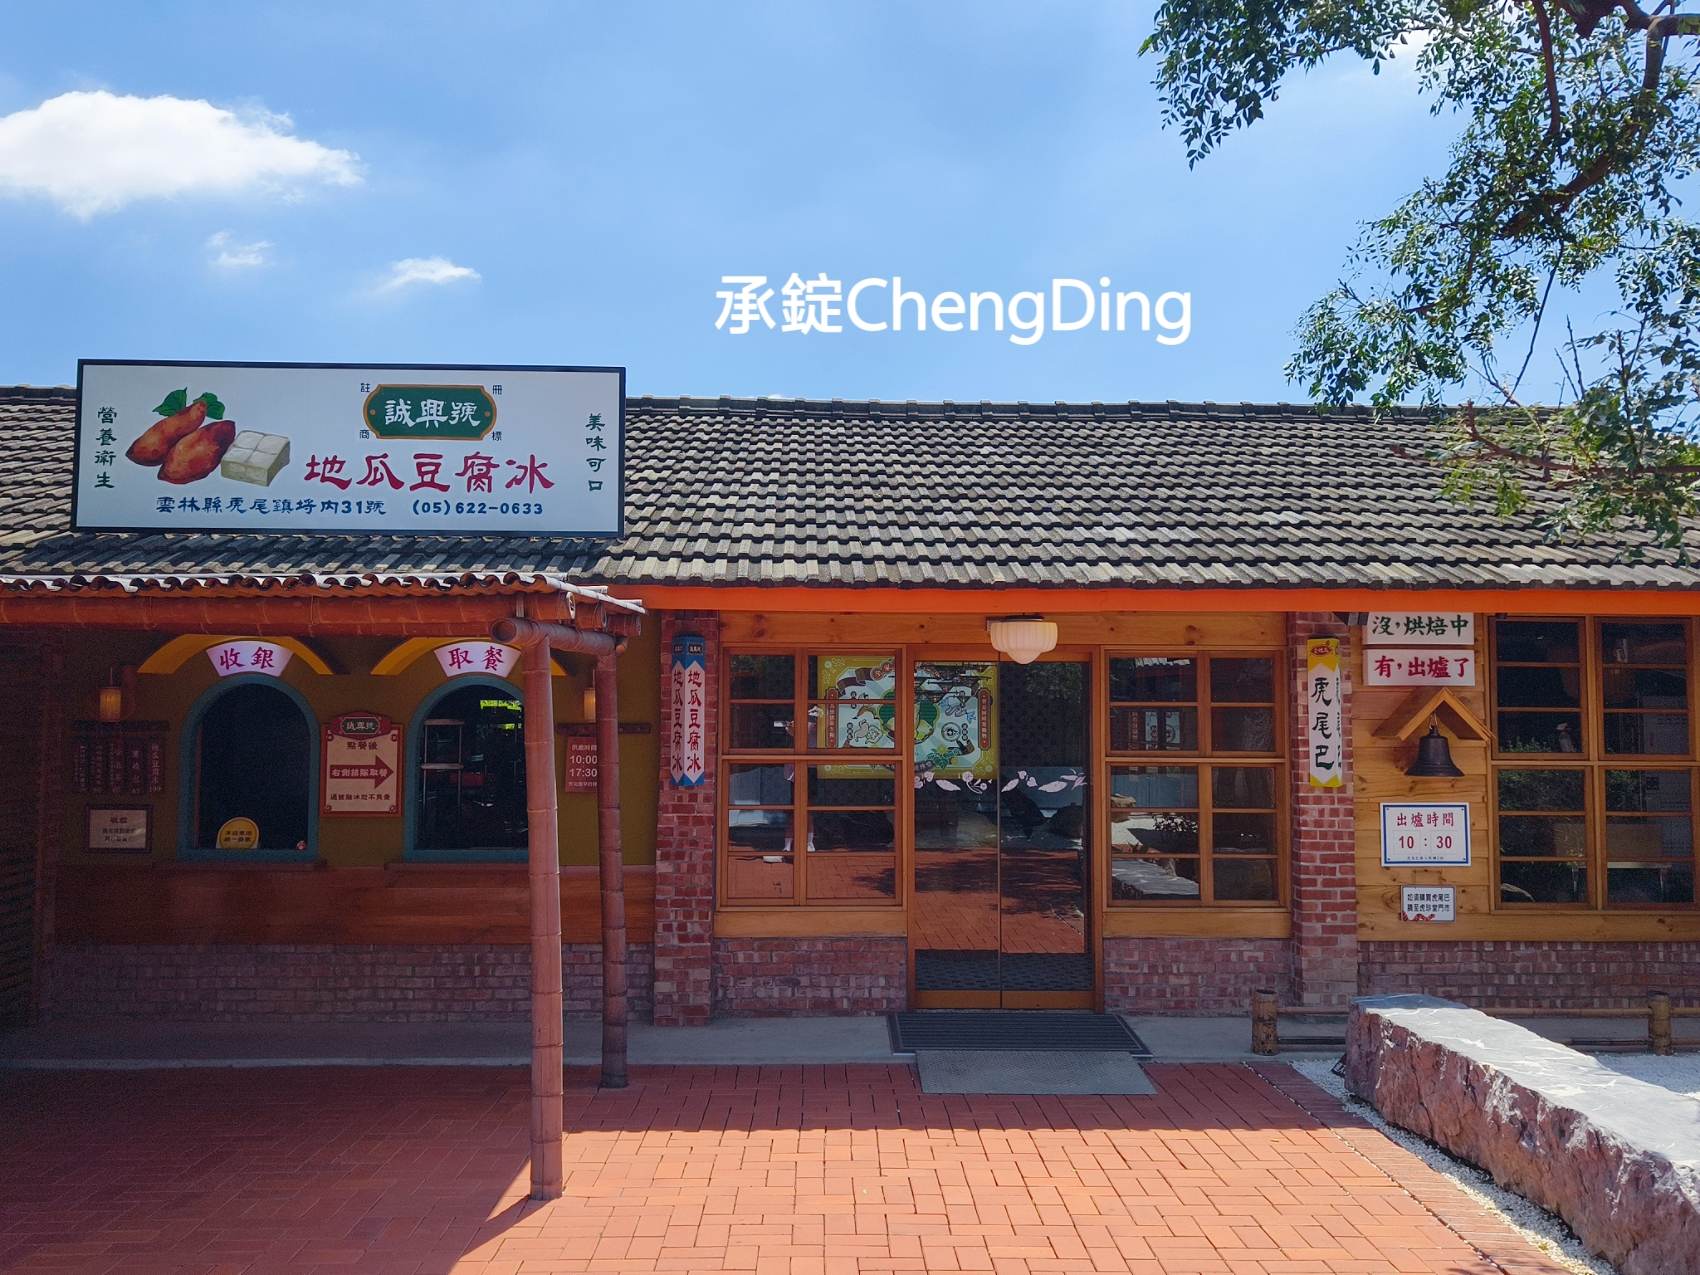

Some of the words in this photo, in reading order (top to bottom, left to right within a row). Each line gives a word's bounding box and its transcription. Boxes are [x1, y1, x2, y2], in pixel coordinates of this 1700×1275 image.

[384, 398, 481, 429] 誠興號
[584, 412, 608, 493] 美味可口
[303, 451, 555, 494] 地瓜豆腐冰
[411, 499, 545, 516] (05)622-0633
[218, 646, 276, 670] 收銀
[448, 645, 505, 672] 取餐
[672, 670, 683, 774] 地瓜豆腐冰
[687, 670, 702, 774] 地瓜豆腐冰
[1311, 677, 1335, 771] 虎尾巴
[569, 754, 598, 765] 10:00
[569, 768, 598, 777] 17:30
[1396, 812, 1455, 828] 出爐時間
